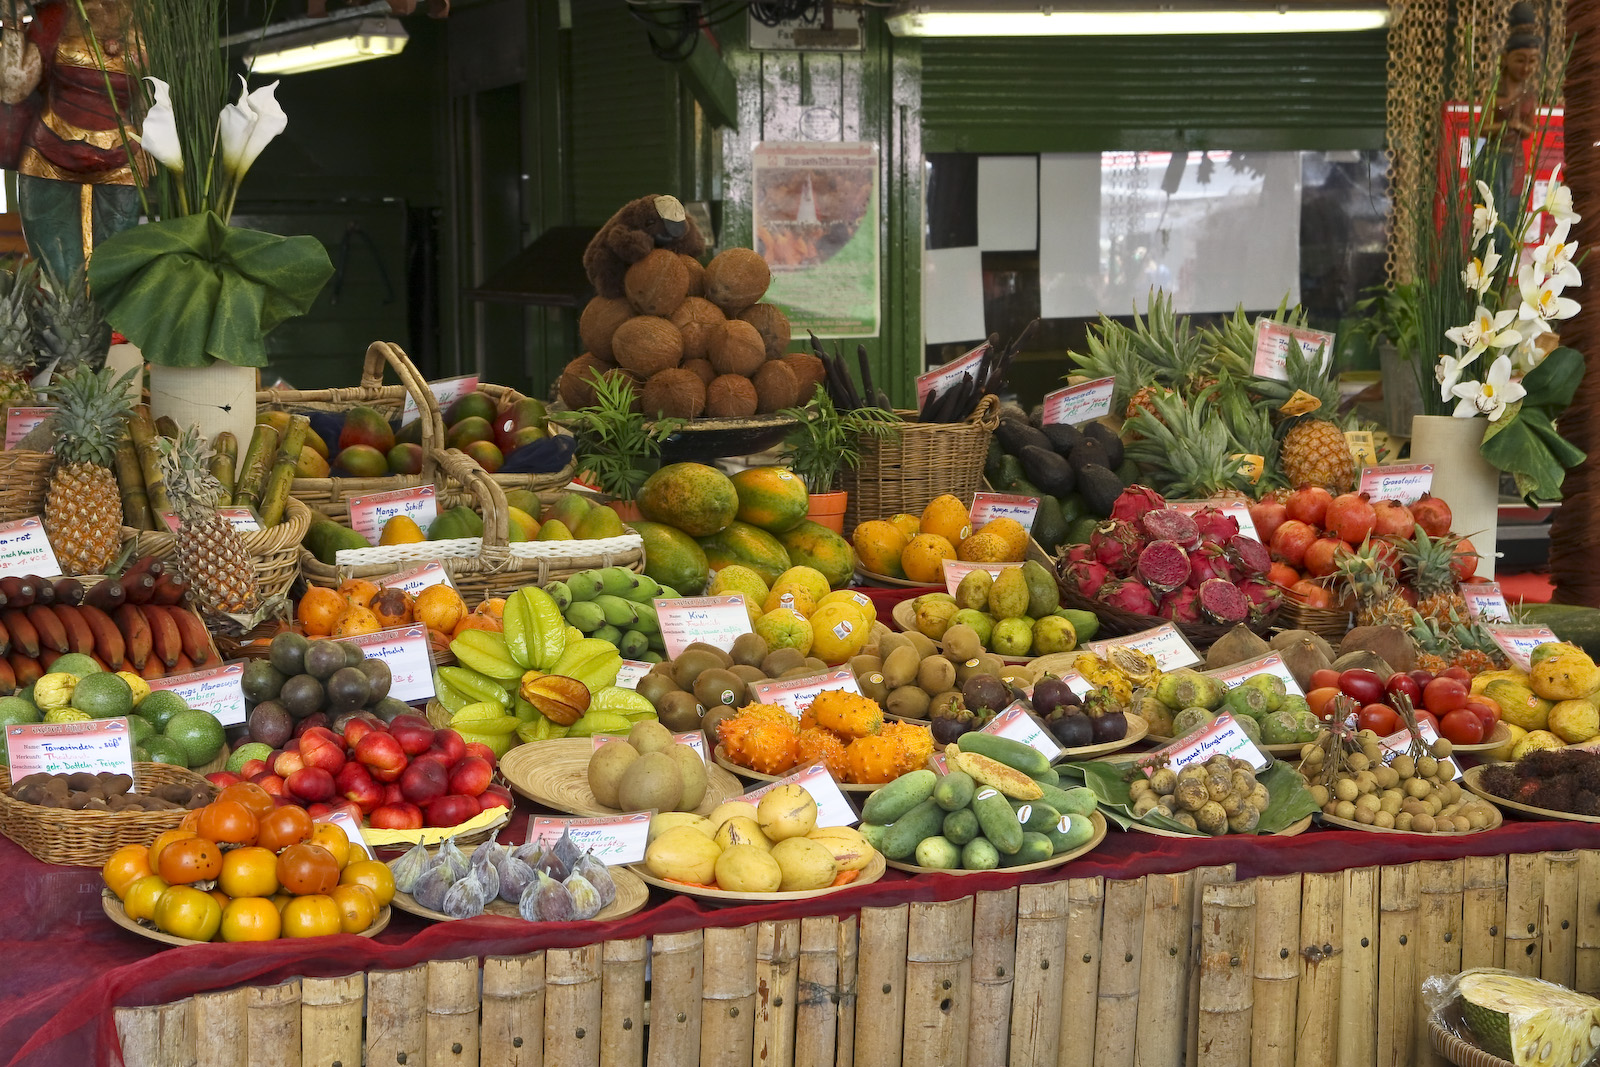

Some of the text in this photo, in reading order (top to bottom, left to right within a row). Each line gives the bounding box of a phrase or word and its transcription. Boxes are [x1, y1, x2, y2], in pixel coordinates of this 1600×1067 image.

[376, 507, 398, 517] Mango
[688, 611, 708, 619] Kiwi
[200, 679, 239, 692] Maracuja
[41, 743, 95, 752] Tamarinden
[97, 758, 126, 769] Feigen
[570, 829, 602, 839] Feigen
